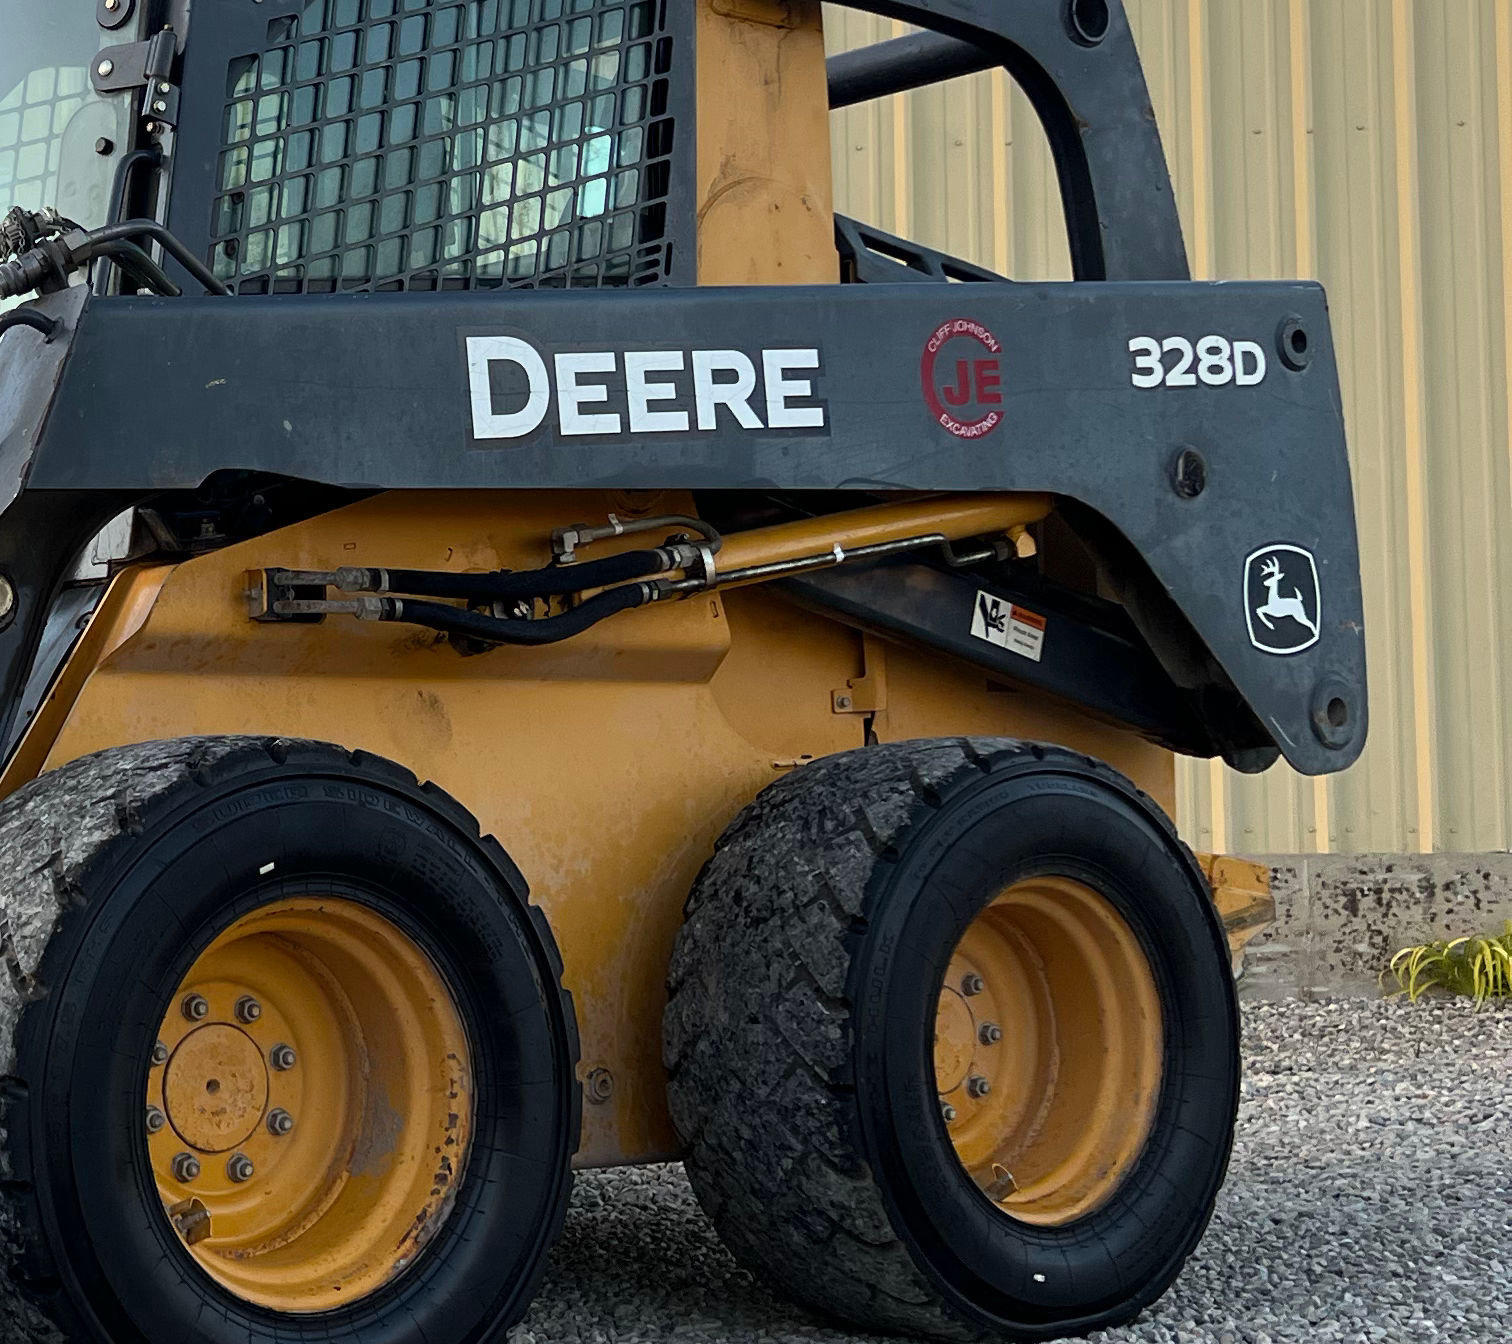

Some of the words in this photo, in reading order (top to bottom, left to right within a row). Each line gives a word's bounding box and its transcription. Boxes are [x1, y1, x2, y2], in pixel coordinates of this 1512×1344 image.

[928, 323, 951, 352] CLIFF
[953, 320, 999, 352] JOHNSON
[1128, 335, 1267, 388] 328D
[465, 336, 825, 440] DEERE
[939, 412, 999, 437] EXCAVATING
